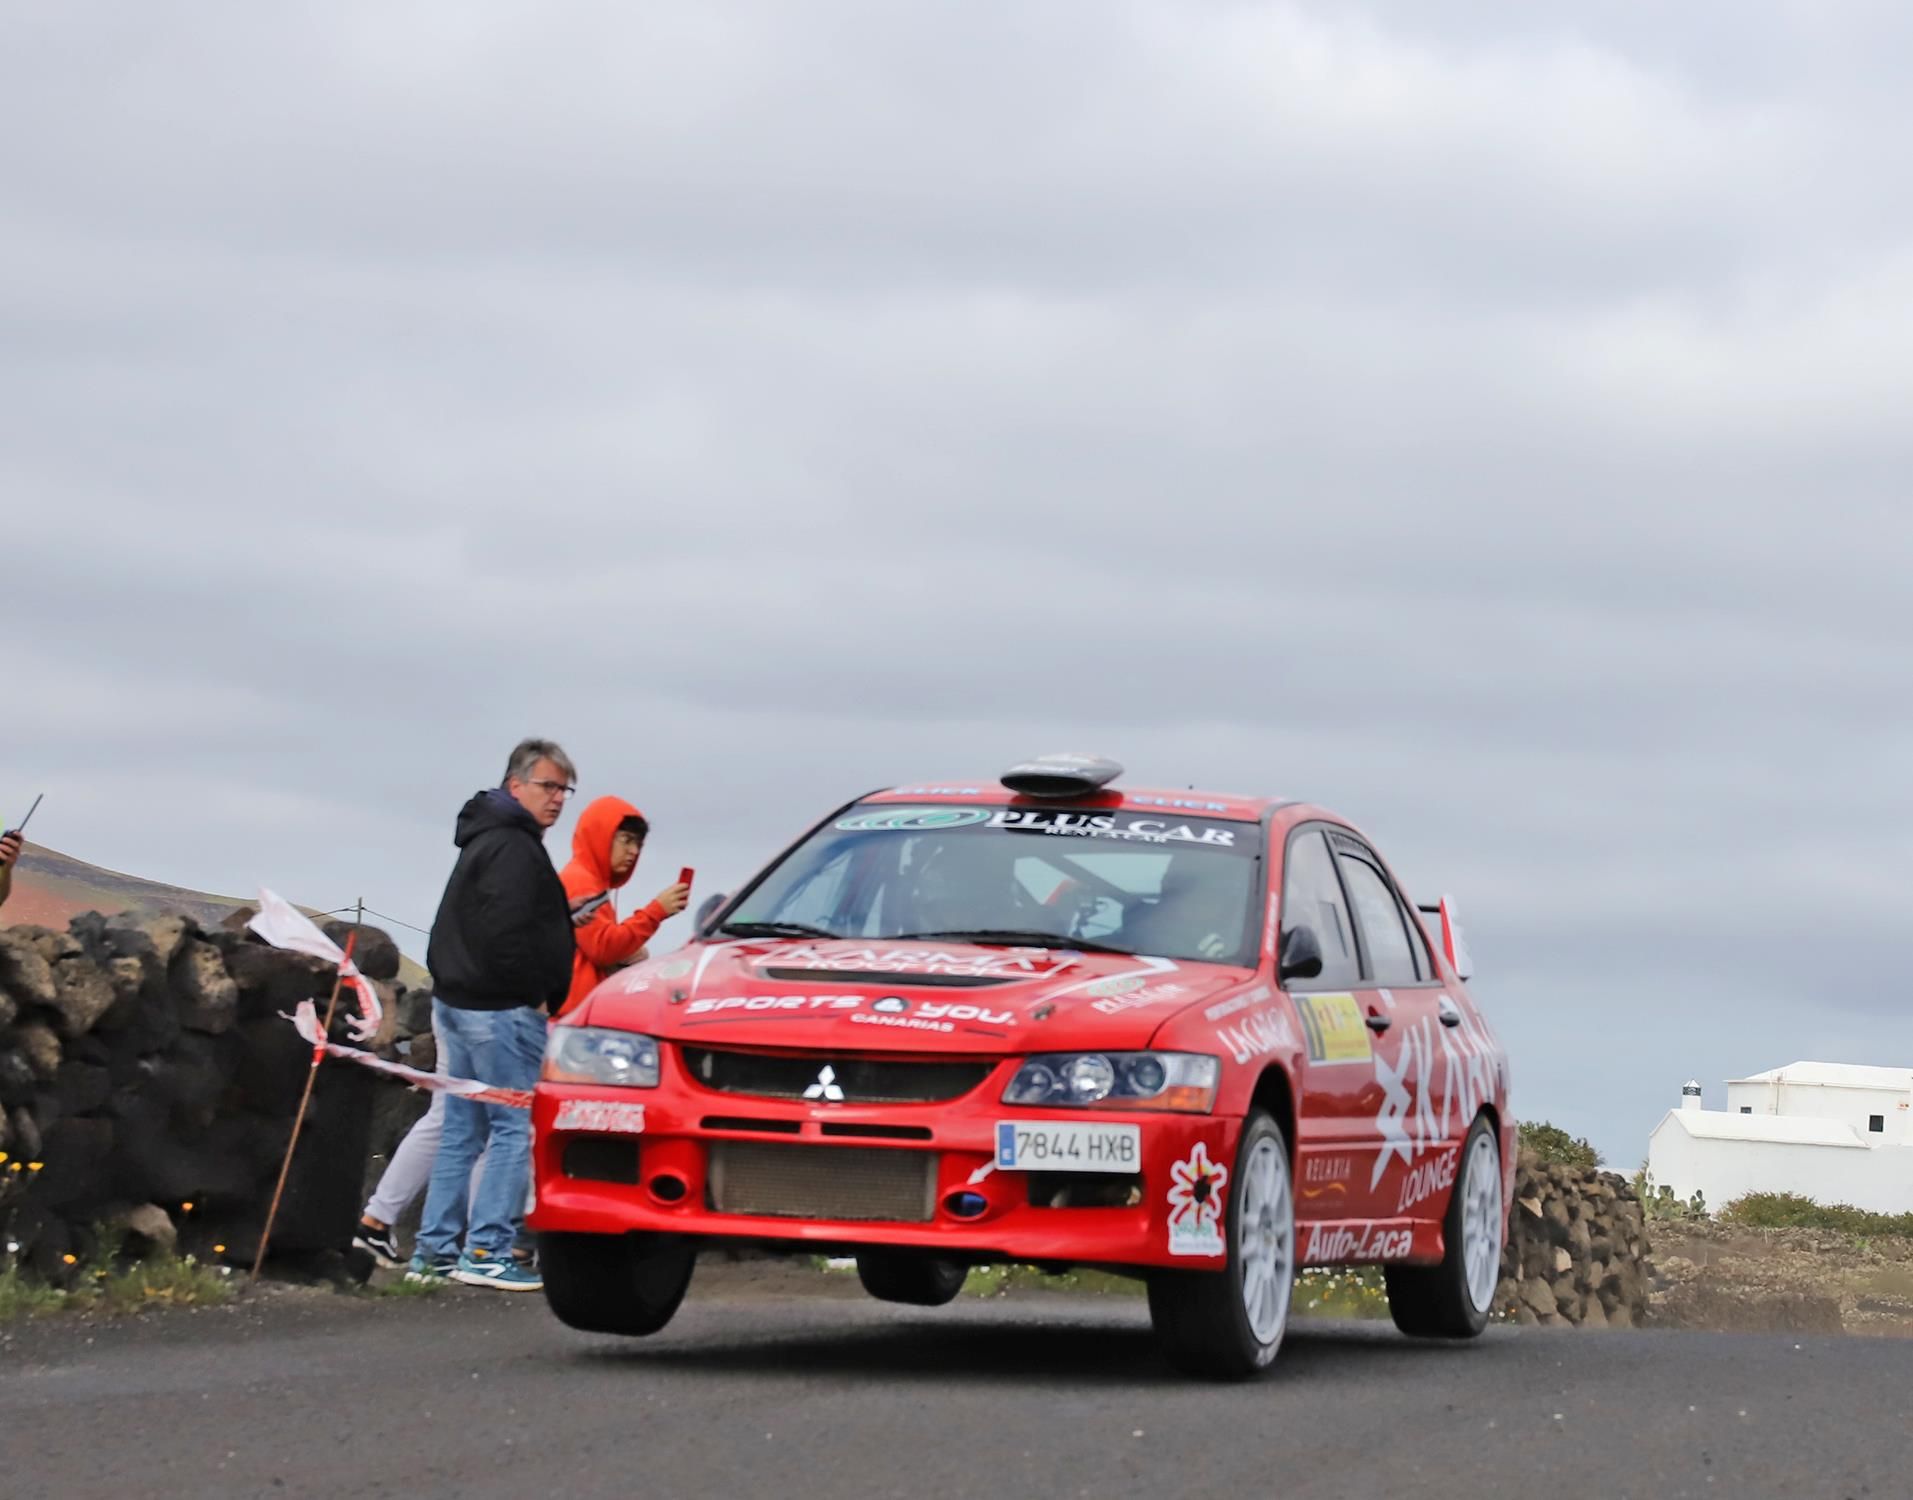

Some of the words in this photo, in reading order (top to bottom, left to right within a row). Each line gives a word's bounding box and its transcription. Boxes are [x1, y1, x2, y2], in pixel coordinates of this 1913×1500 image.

[985, 809, 1116, 832] PLUS
[1127, 819, 1235, 847] CAR
[686, 995, 866, 1015] SPORTS
[850, 1013, 955, 1033] CANARIAS
[1016, 1131, 1081, 1160] 7844
[1088, 1135, 1136, 1163] HXB
[1397, 1147, 1457, 1213] LOUNGE
[1304, 1220, 1413, 1263] Auto-Laca
